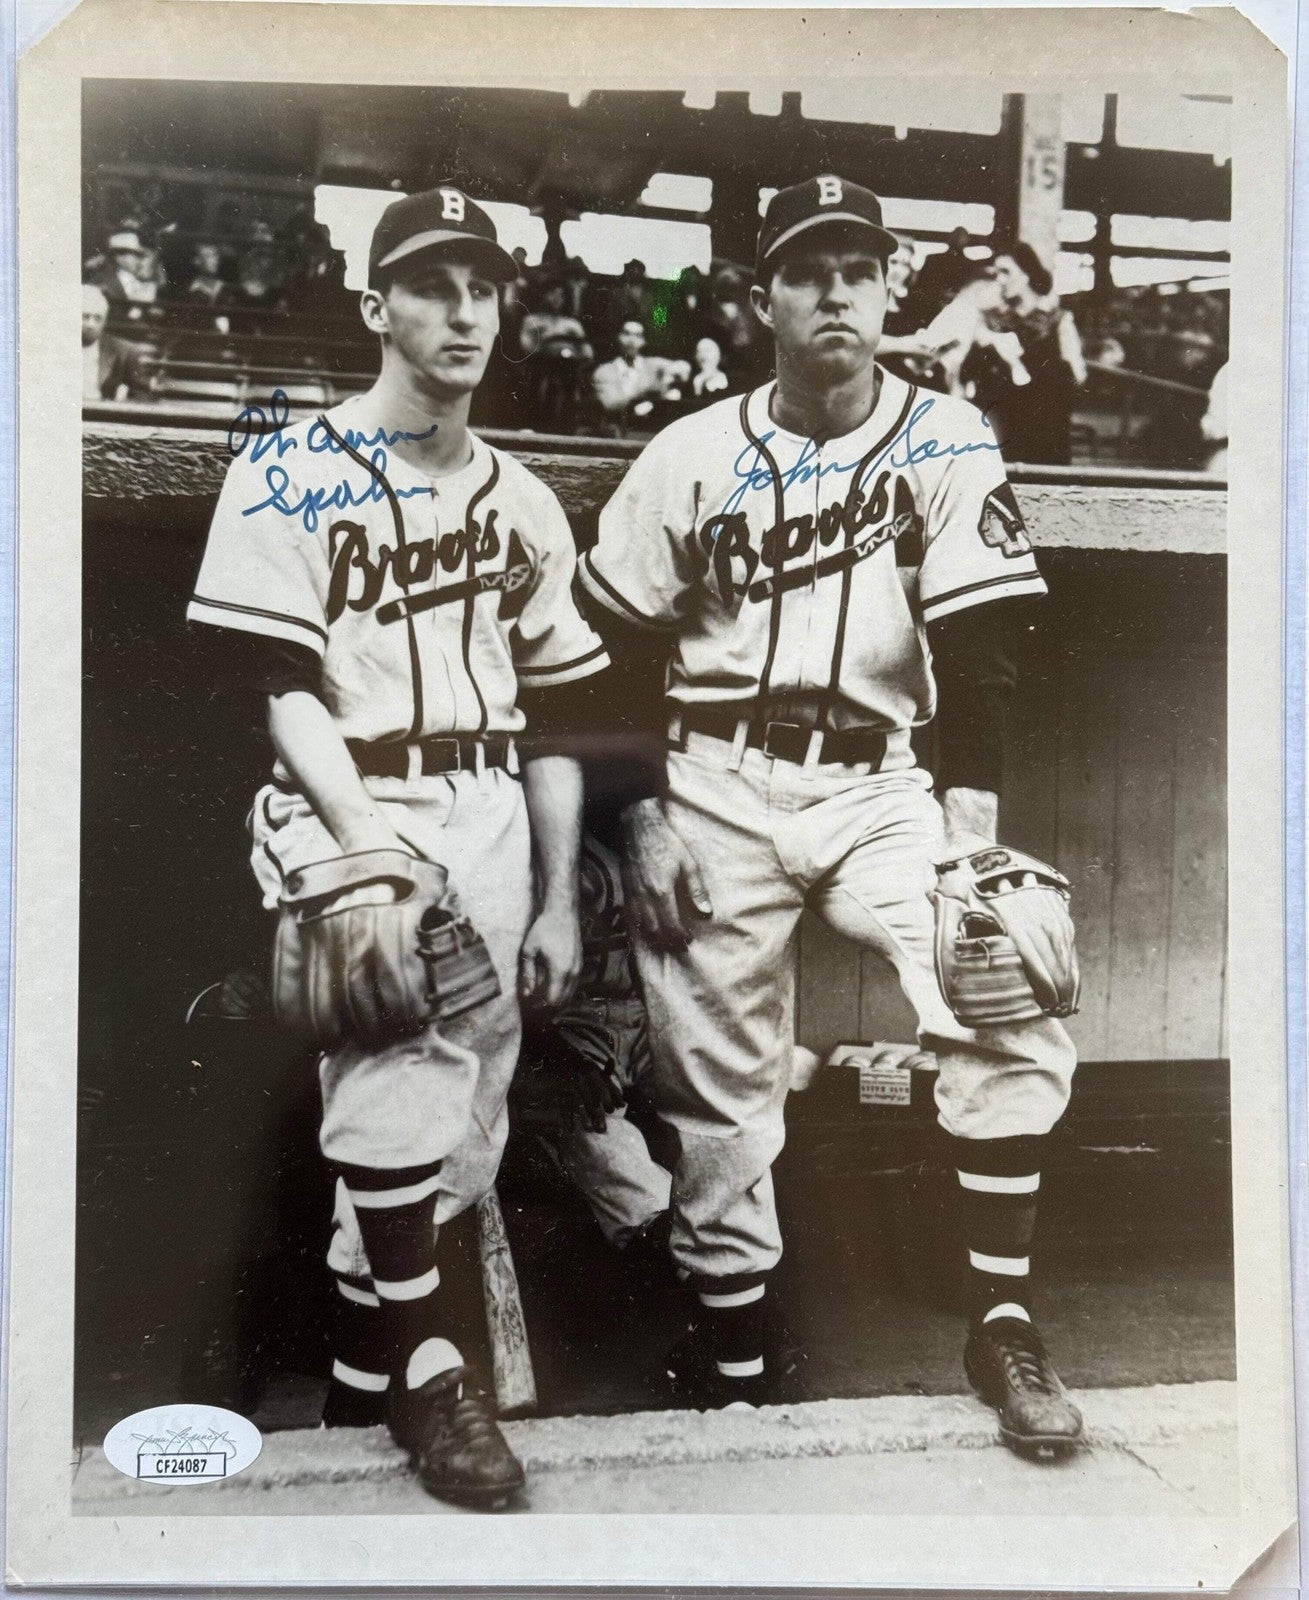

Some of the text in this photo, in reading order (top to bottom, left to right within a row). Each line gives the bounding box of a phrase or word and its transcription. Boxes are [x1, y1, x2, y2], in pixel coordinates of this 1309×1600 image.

[439, 189, 465, 222] B
[816, 176, 843, 206] B
[700, 470, 893, 606] Baves
[325, 508, 502, 626] Braves
[156, 1459, 208, 1474] CF24087
